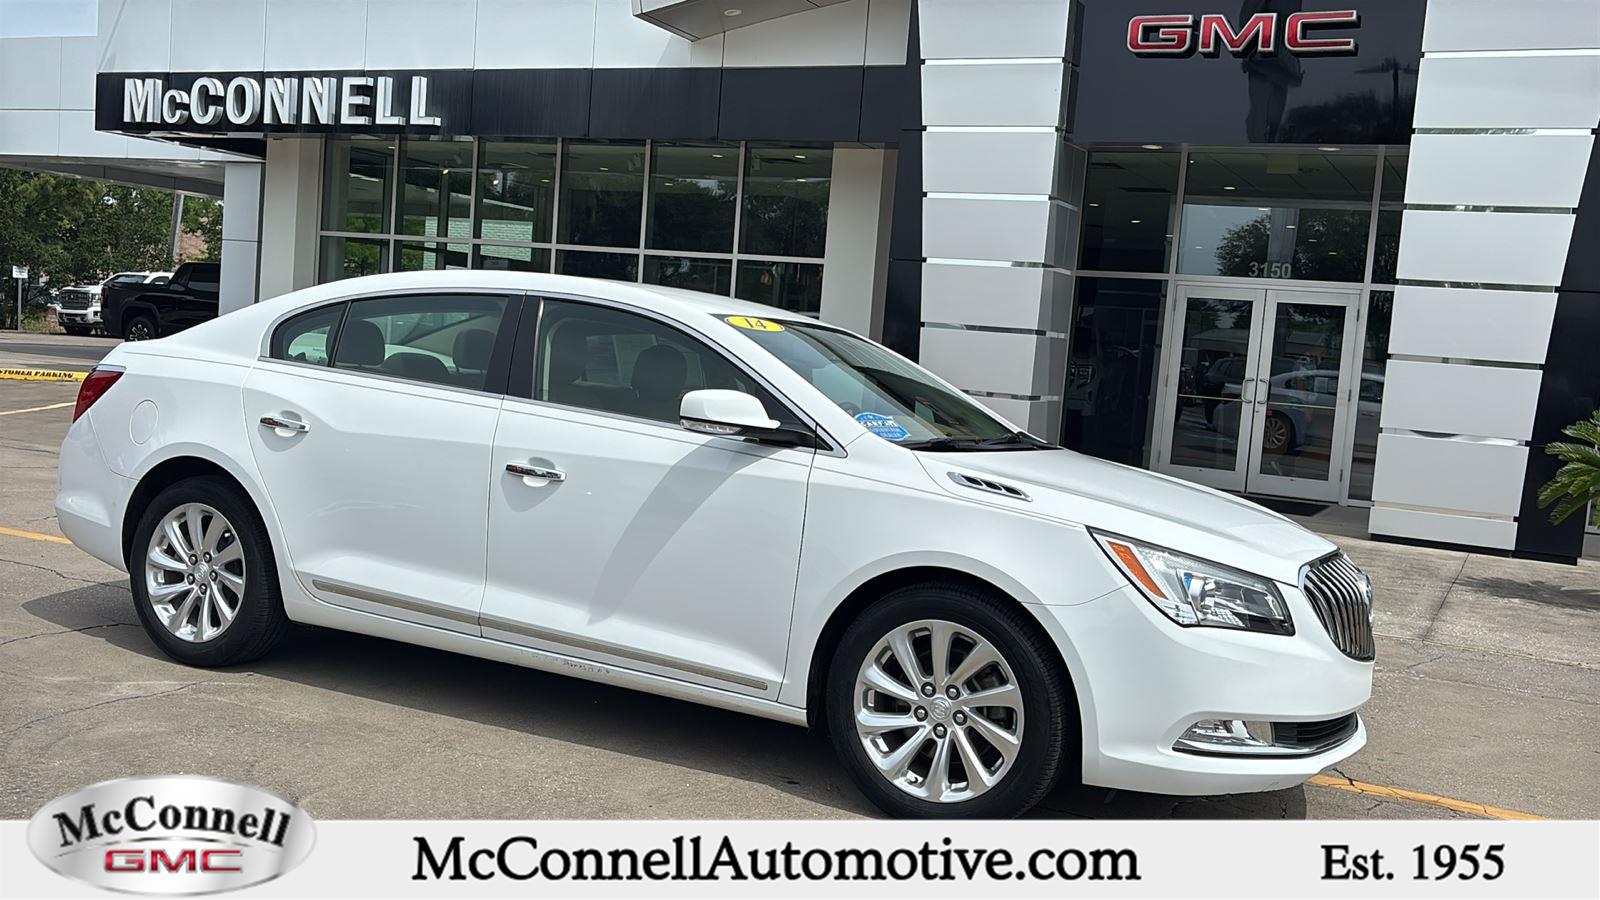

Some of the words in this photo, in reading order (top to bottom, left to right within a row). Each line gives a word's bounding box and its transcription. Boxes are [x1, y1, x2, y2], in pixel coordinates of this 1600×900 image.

[1127, 9, 1360, 58] GMC
[122, 75, 442, 127] McCONNELL
[1248, 261, 1292, 278] 3150
[744, 317, 767, 329] 14
